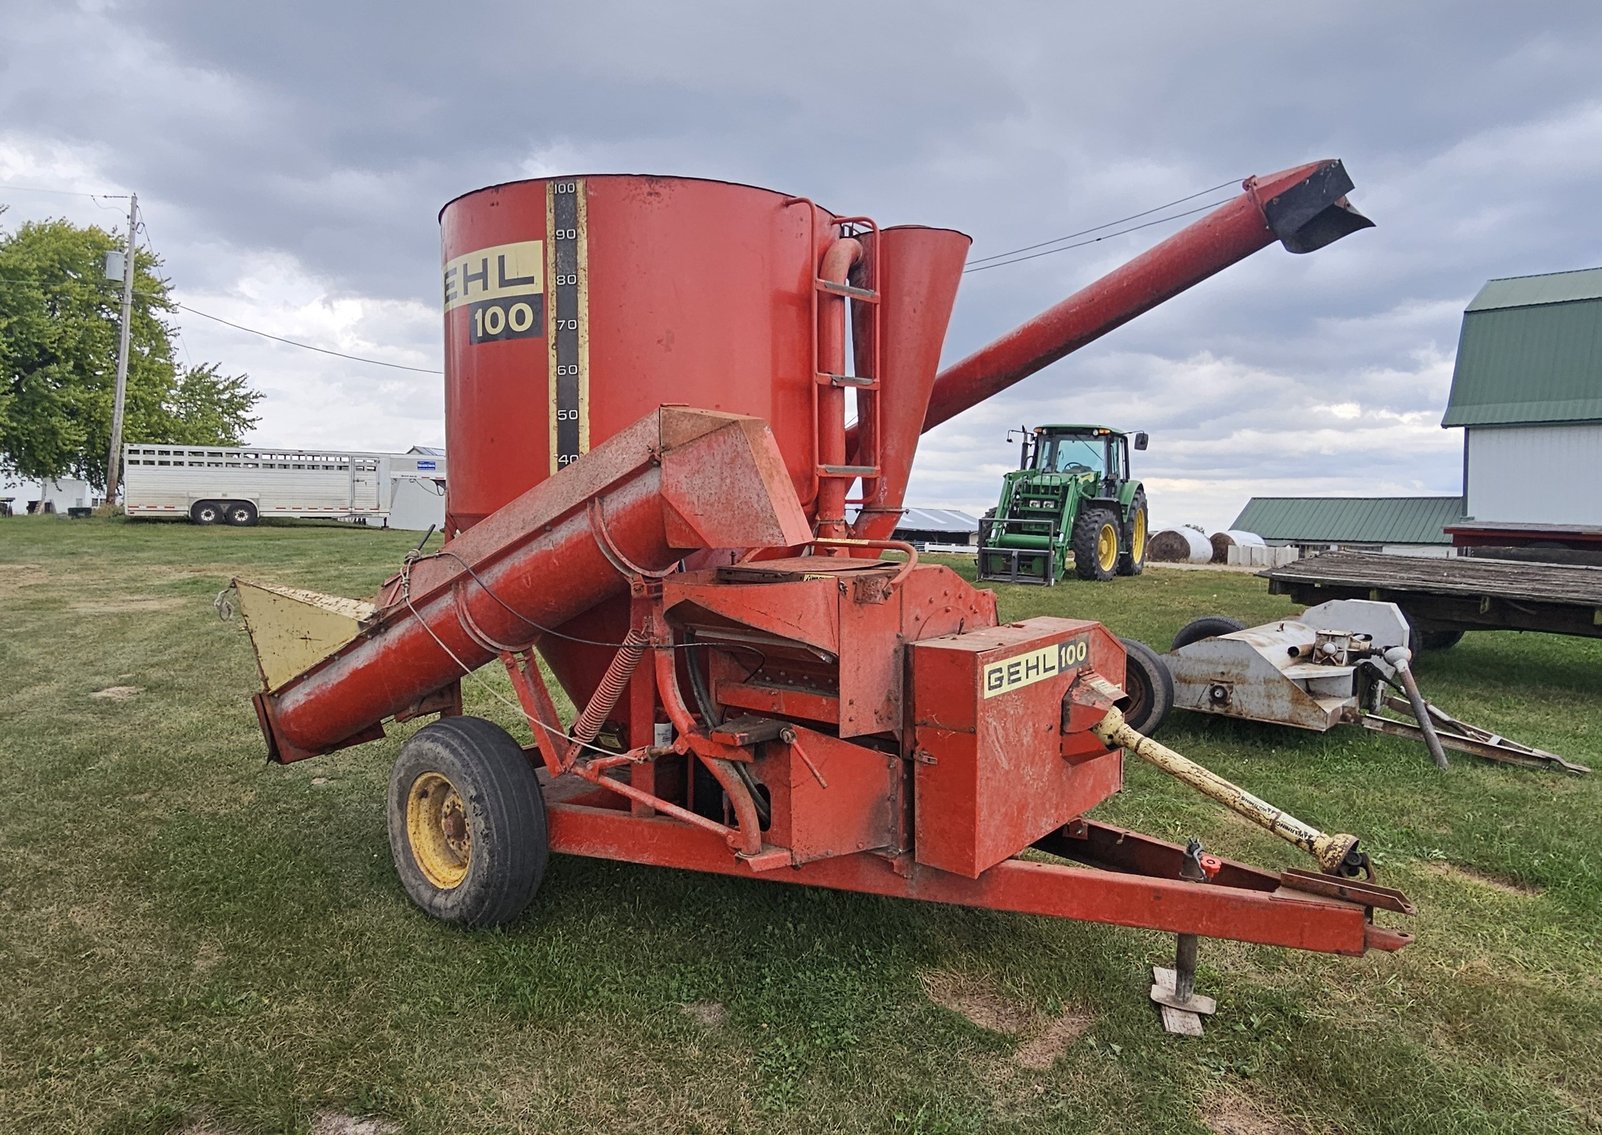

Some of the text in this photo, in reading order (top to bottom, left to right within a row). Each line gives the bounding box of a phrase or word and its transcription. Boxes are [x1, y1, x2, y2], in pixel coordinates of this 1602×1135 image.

[554, 182, 576, 194] 100
[555, 229, 576, 240] 90
[444, 254, 535, 305] EHL
[556, 274, 577, 286] 80
[474, 302, 534, 337] 100
[557, 319, 578, 331] 70
[557, 364, 579, 376] 60
[557, 409, 579, 421] 50
[558, 454, 579, 466] 40
[987, 641, 1087, 691] GEHL 100
